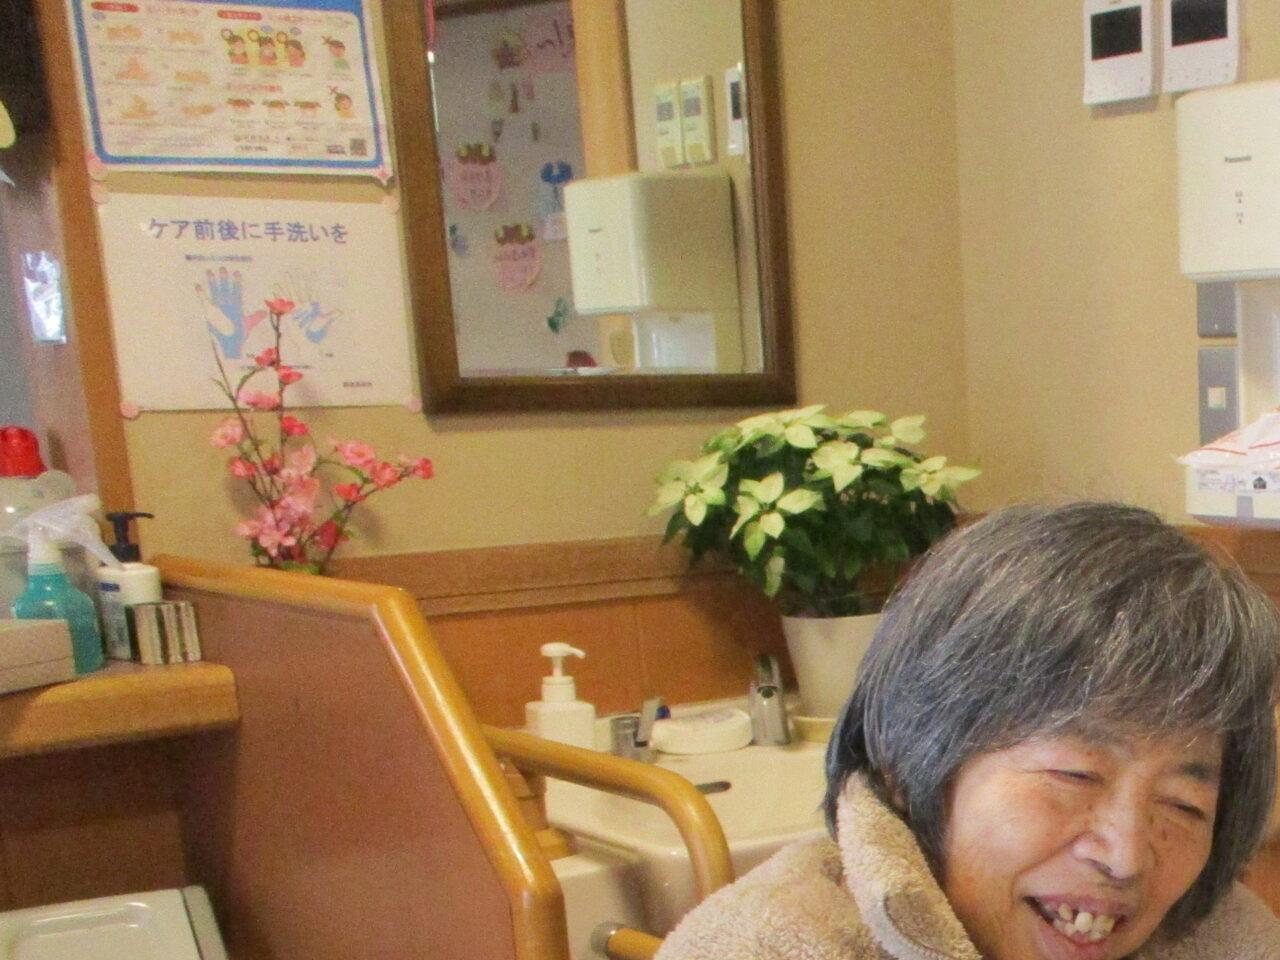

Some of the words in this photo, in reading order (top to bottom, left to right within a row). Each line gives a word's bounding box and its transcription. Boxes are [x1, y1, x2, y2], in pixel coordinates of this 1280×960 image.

[149, 218, 349, 244] ケア前後に手洗いを
